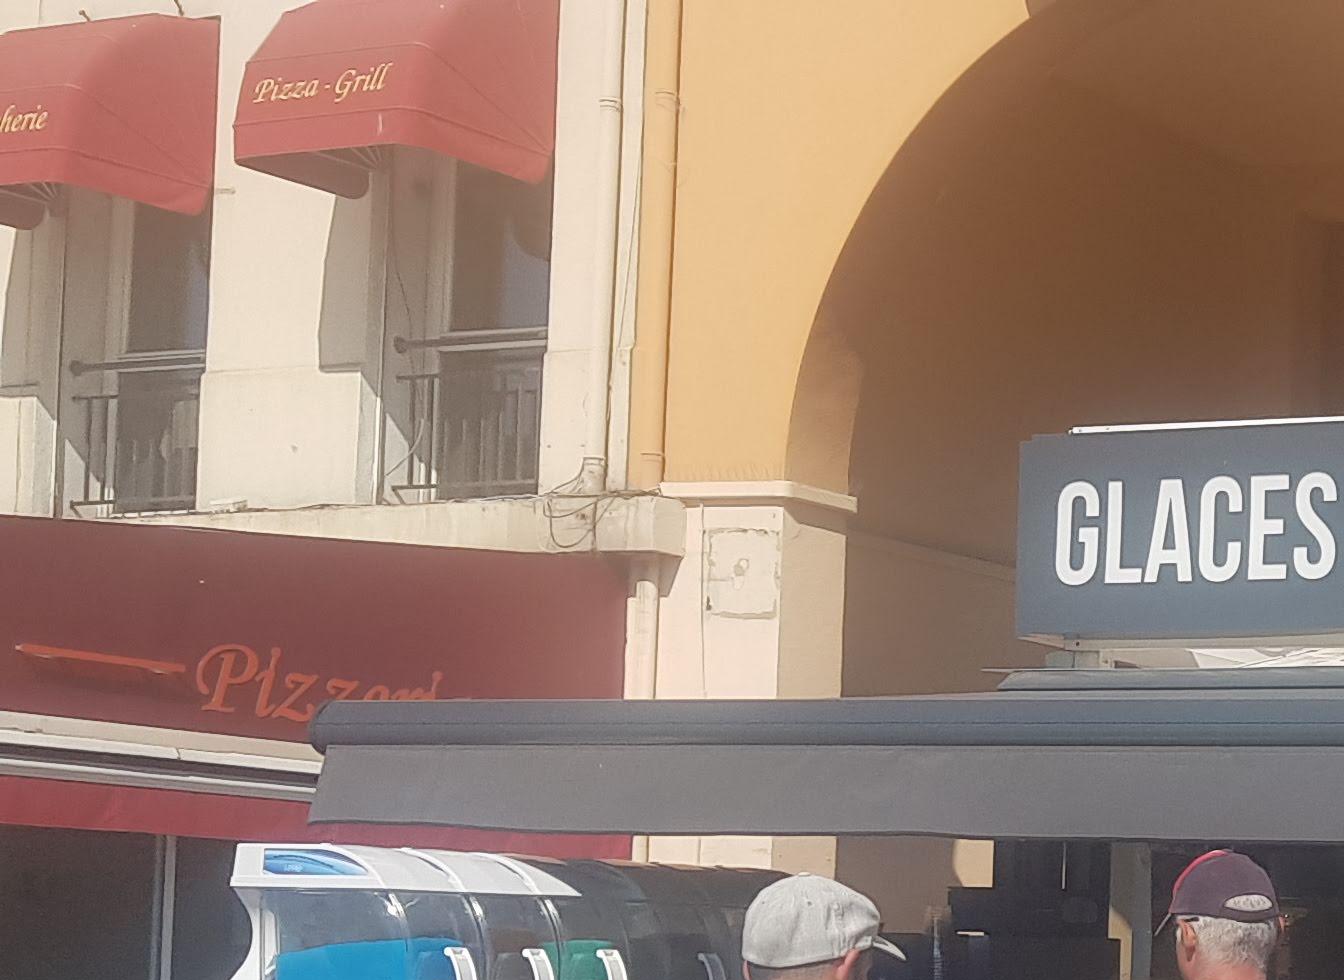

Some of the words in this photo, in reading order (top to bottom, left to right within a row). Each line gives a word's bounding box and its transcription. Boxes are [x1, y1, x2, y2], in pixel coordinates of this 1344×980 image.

[252, 77, 320, 103] Pizza
[333, 62, 393, 103] Grill
[0, 104, 49, 133] herie
[1055, 471, 1338, 585] GLACES
